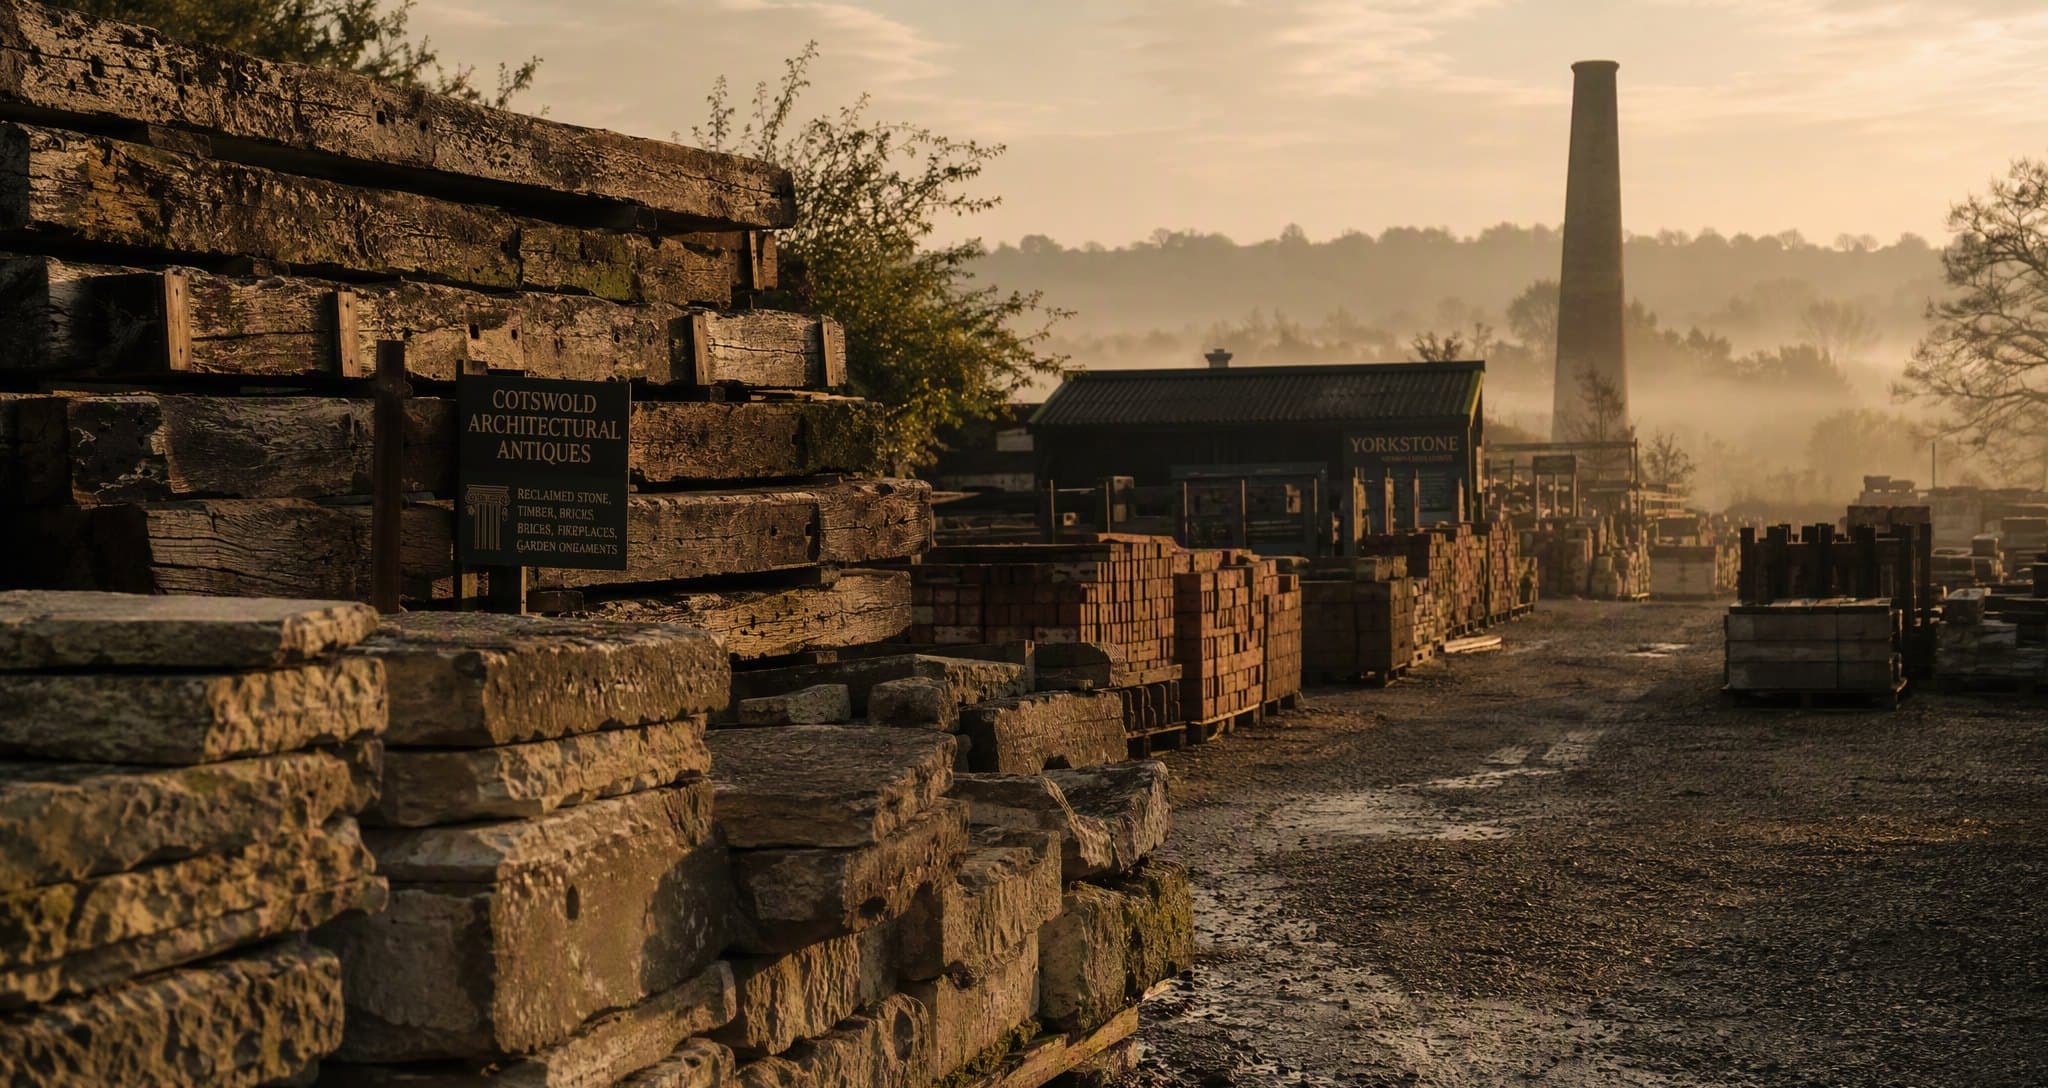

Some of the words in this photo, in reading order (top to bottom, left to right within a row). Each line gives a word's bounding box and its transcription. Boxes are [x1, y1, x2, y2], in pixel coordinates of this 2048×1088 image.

[493, 389, 597, 413] COTSWOLD
[467, 414, 621, 439] ARCHITECTURAL
[496, 440, 592, 464] ANTIQUES
[1351, 436, 1459, 453] YORKSTONE
[517, 488, 574, 502] RECLAIMED
[517, 505, 557, 519] TIMBER,
[558, 525, 618, 540] FIREPLACES,
[516, 540, 556, 553] GARDEN
